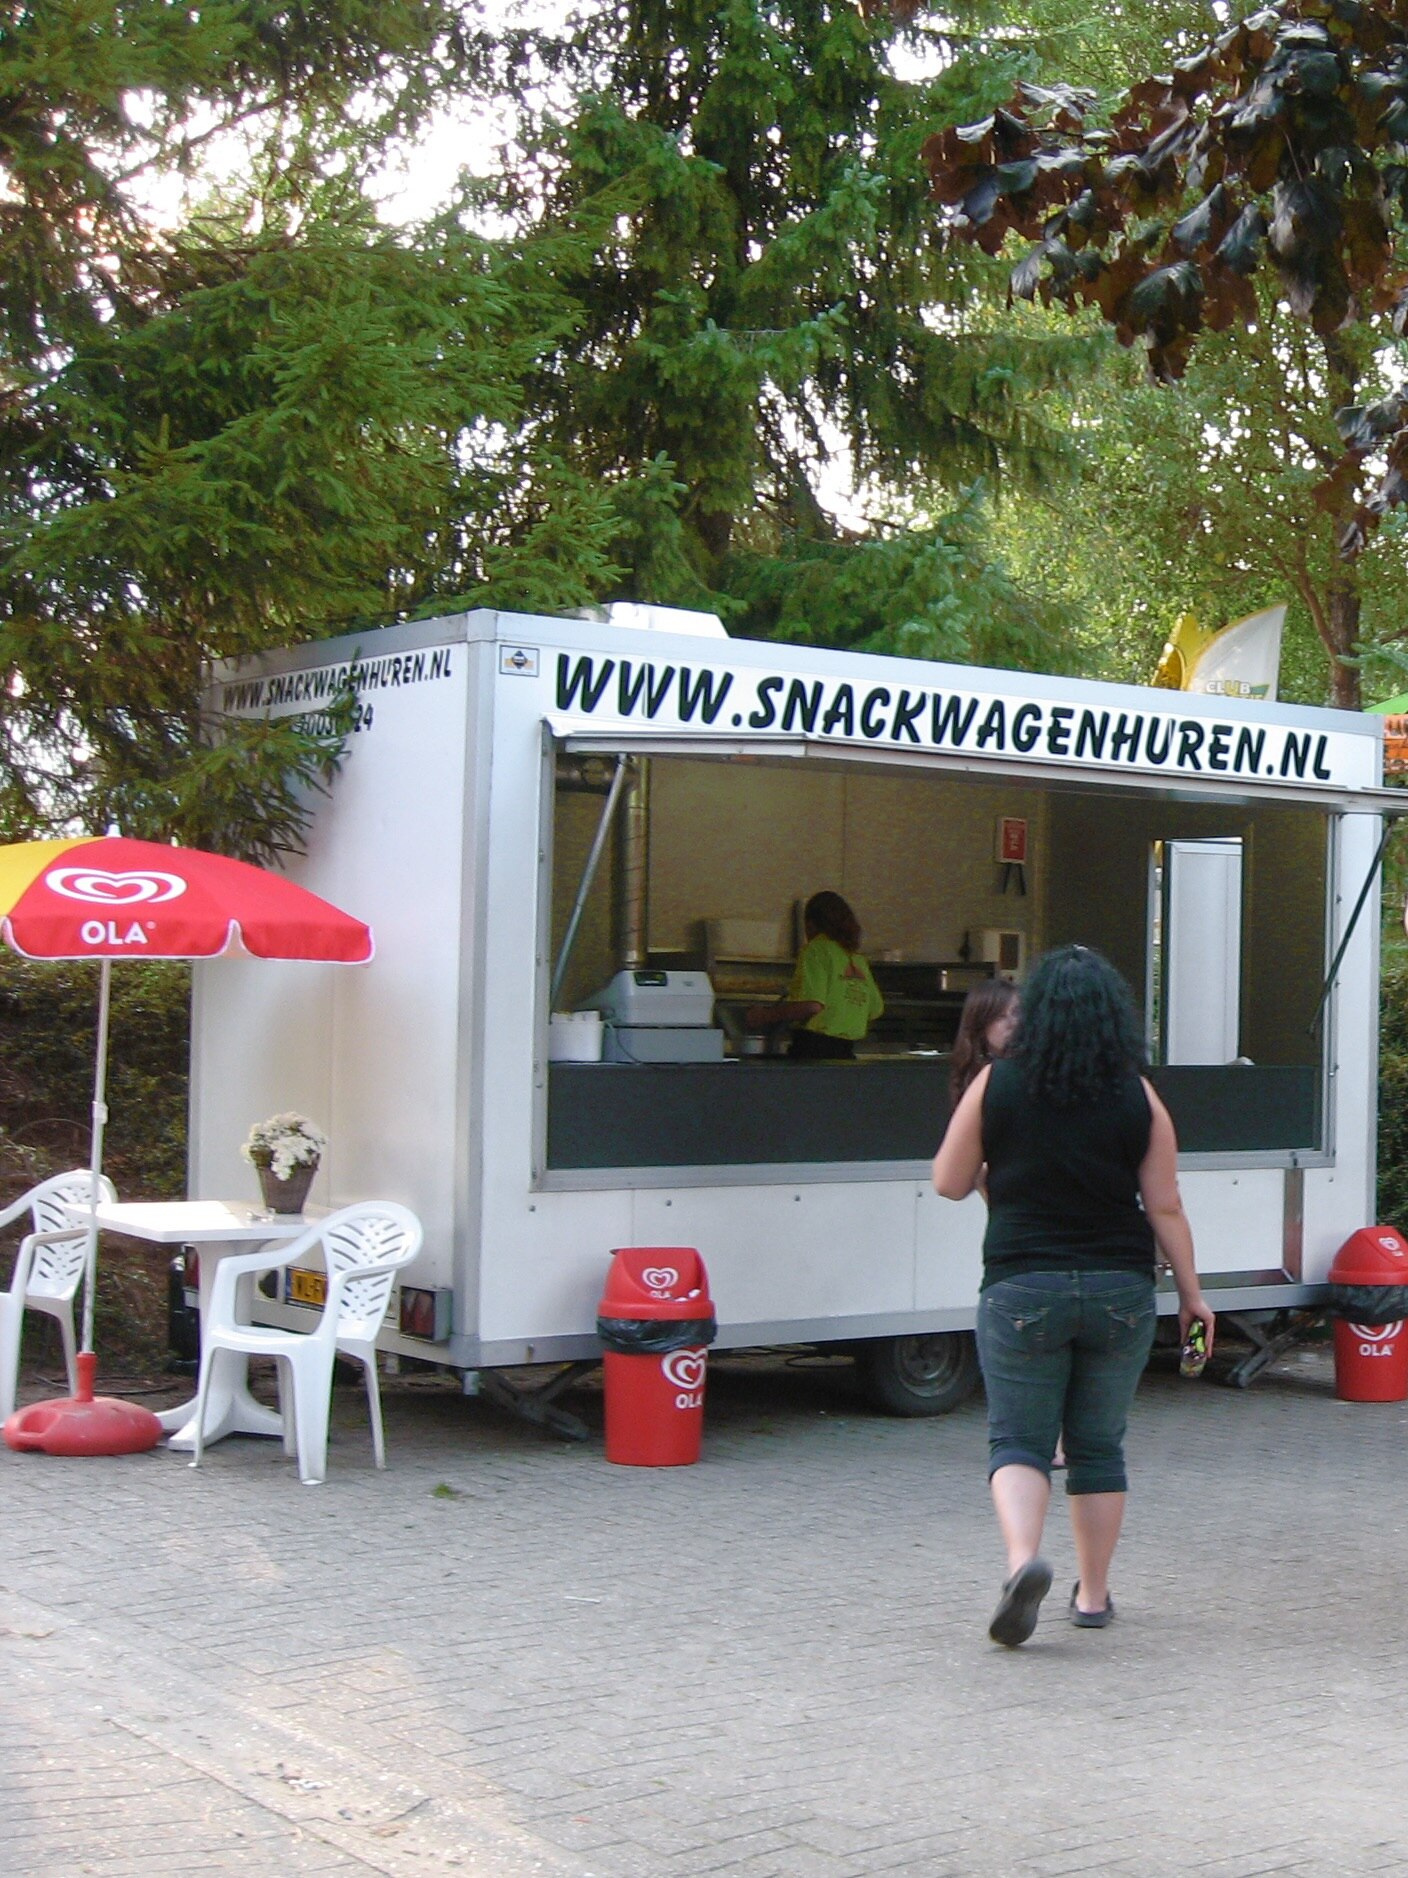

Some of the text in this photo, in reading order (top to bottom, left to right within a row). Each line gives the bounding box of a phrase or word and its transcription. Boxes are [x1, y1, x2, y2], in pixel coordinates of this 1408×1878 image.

[1205, 680, 1252, 696] CLUB
[555, 652, 1332, 780] WWW.SNACKWAGENHUREN.NL
[1358, 1343, 1394, 1357] OLA
